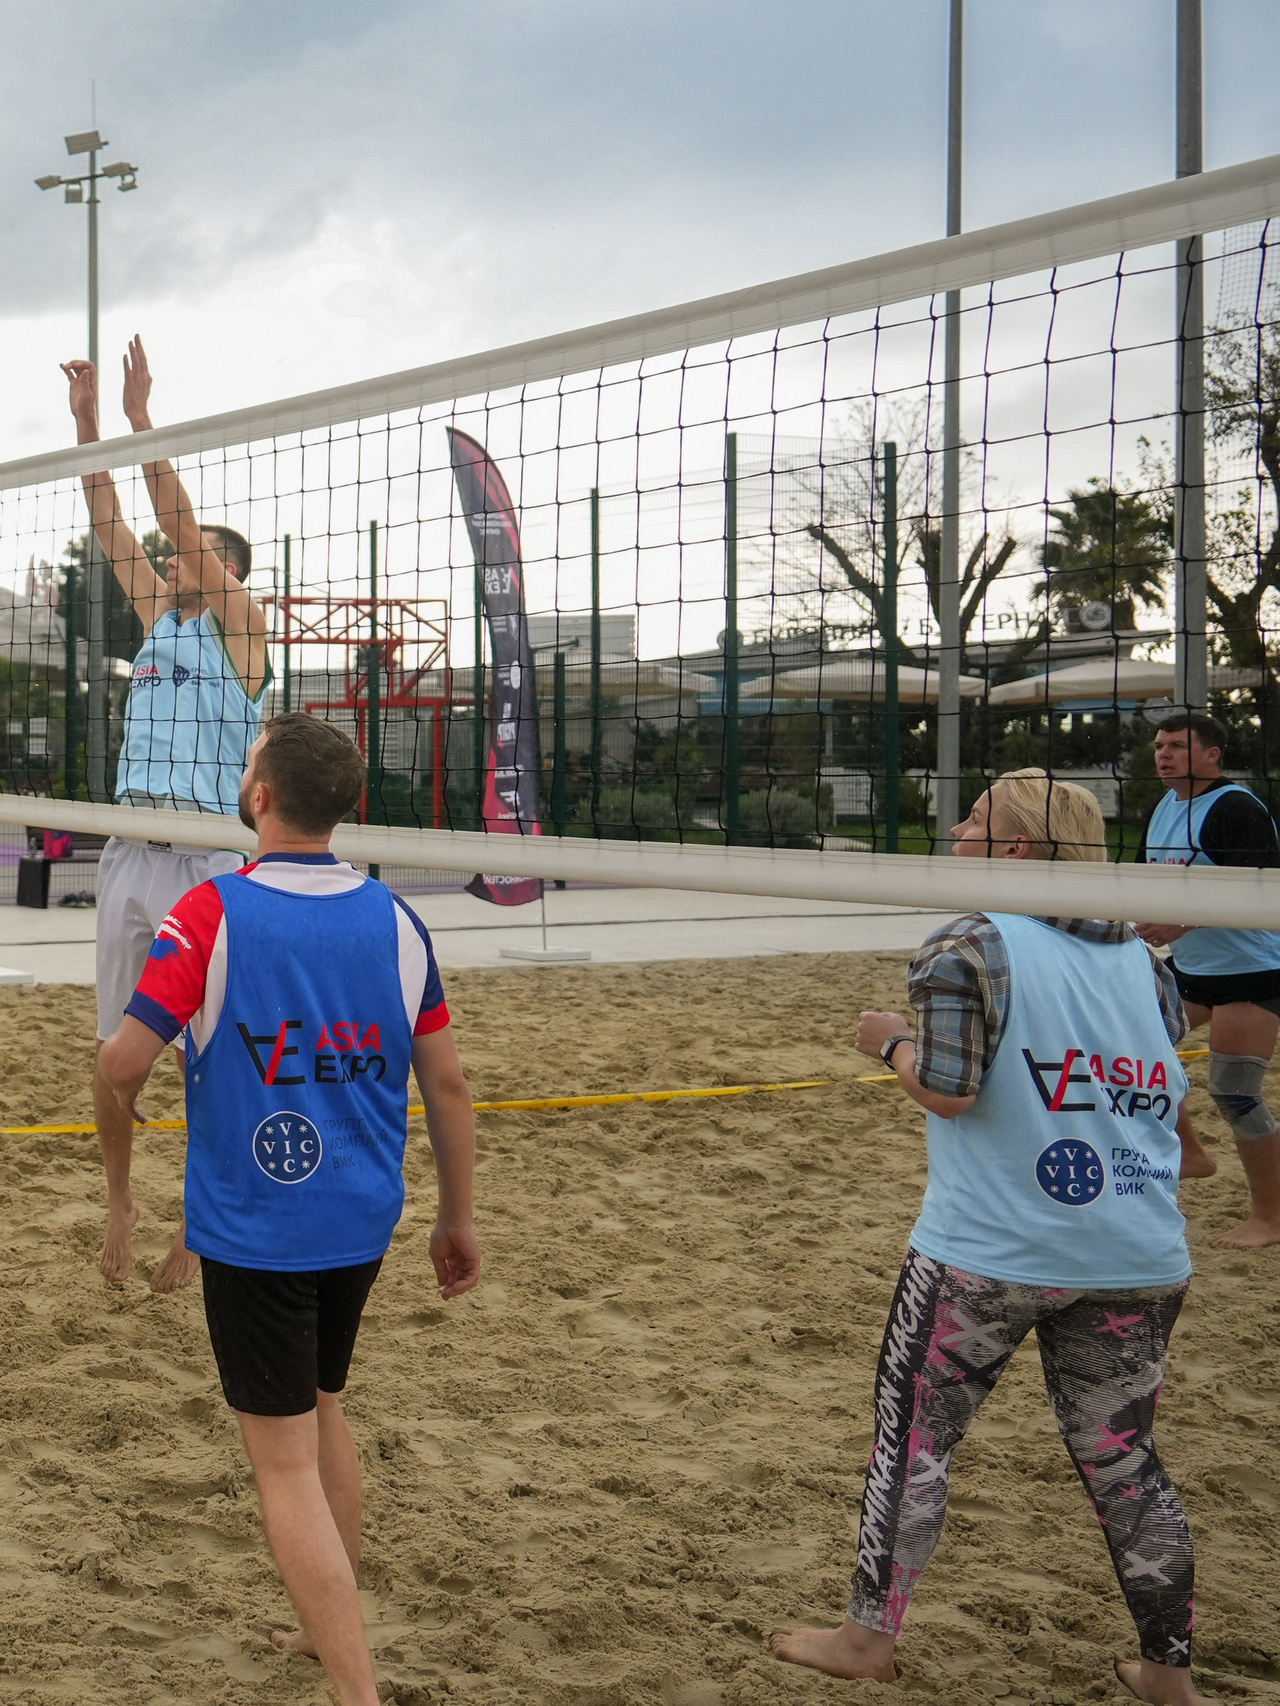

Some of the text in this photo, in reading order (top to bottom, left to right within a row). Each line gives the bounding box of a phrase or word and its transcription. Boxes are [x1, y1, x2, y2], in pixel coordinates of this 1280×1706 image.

[315, 1020, 381, 1052] ASIA
[314, 1054, 387, 1084] EXPO
[1089, 1053, 1168, 1091] ASIA
[1100, 1087, 1171, 1121] XPO
[323, 1118, 369, 1132] ГРУПП
[332, 1154, 356, 1169] ВИК
[1115, 1182, 1145, 1196] ВИК
[857, 1250, 941, 1587] DOMINATION MACHIN
